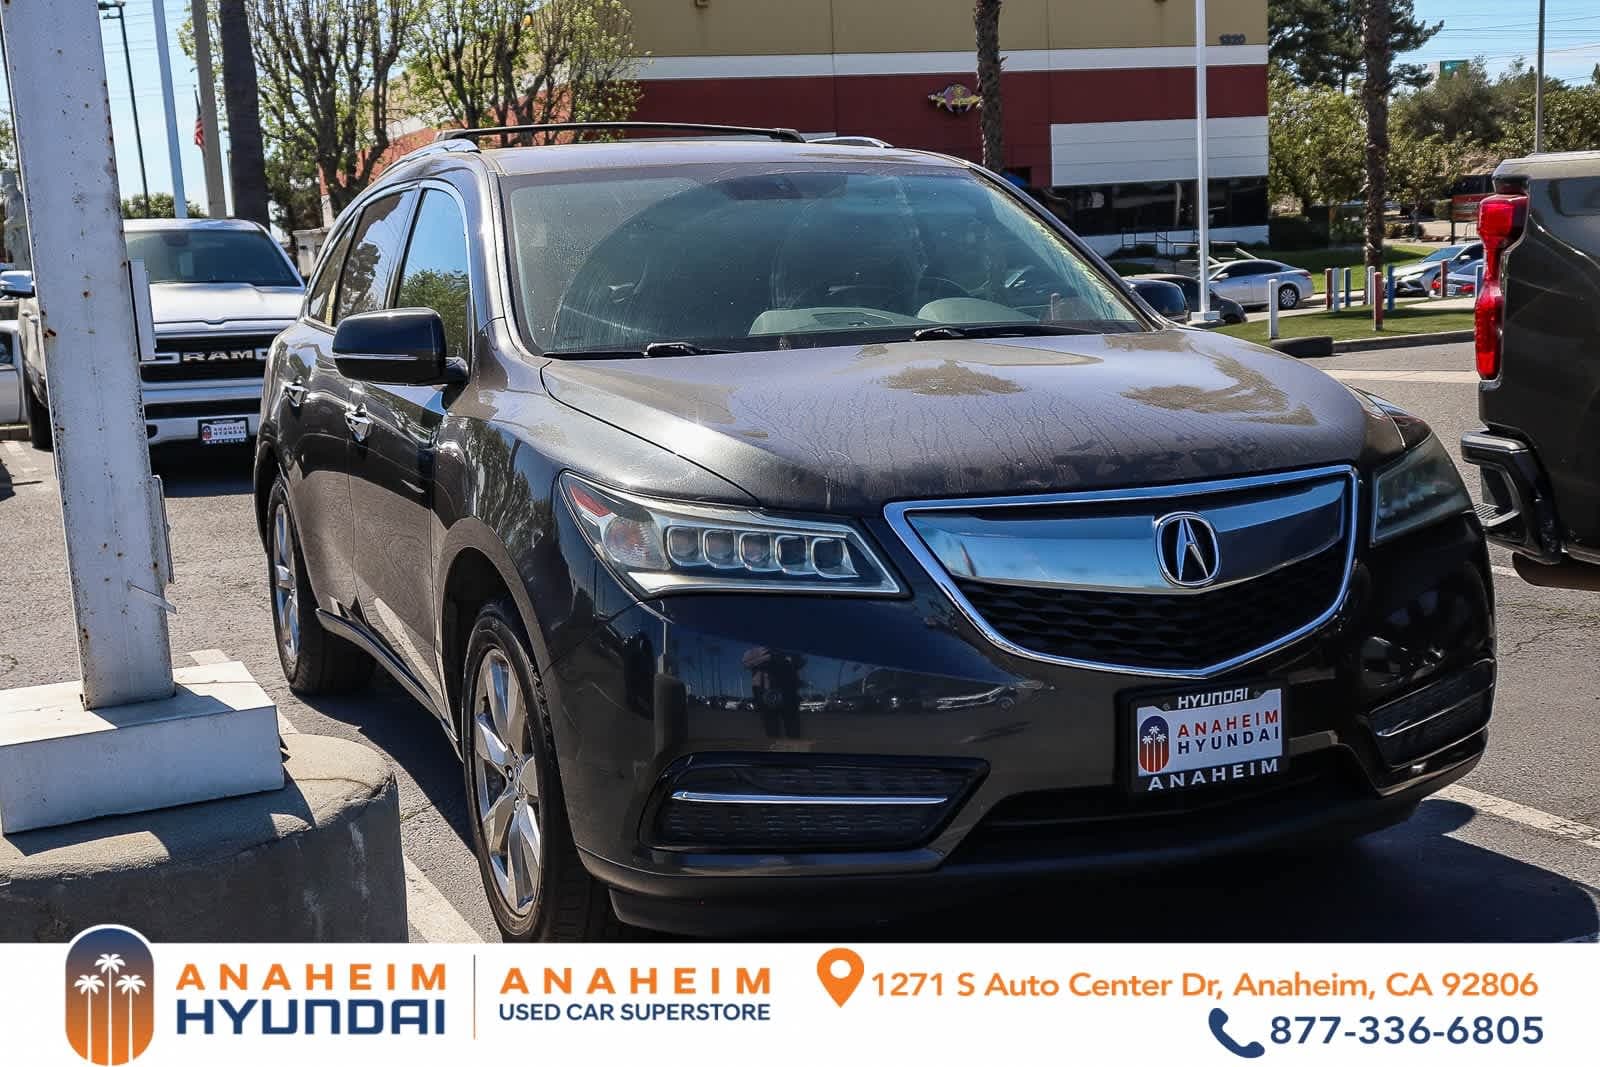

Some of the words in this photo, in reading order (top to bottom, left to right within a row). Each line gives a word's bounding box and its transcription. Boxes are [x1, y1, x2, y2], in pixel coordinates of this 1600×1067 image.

[182, 350, 253, 361] RAM
[1177, 687, 1249, 709] HYUNDAI
[1177, 709, 1279, 738] ANAHEIM
[1177, 726, 1279, 755] HYUNDAI
[1147, 758, 1279, 791] ANAHEIM
